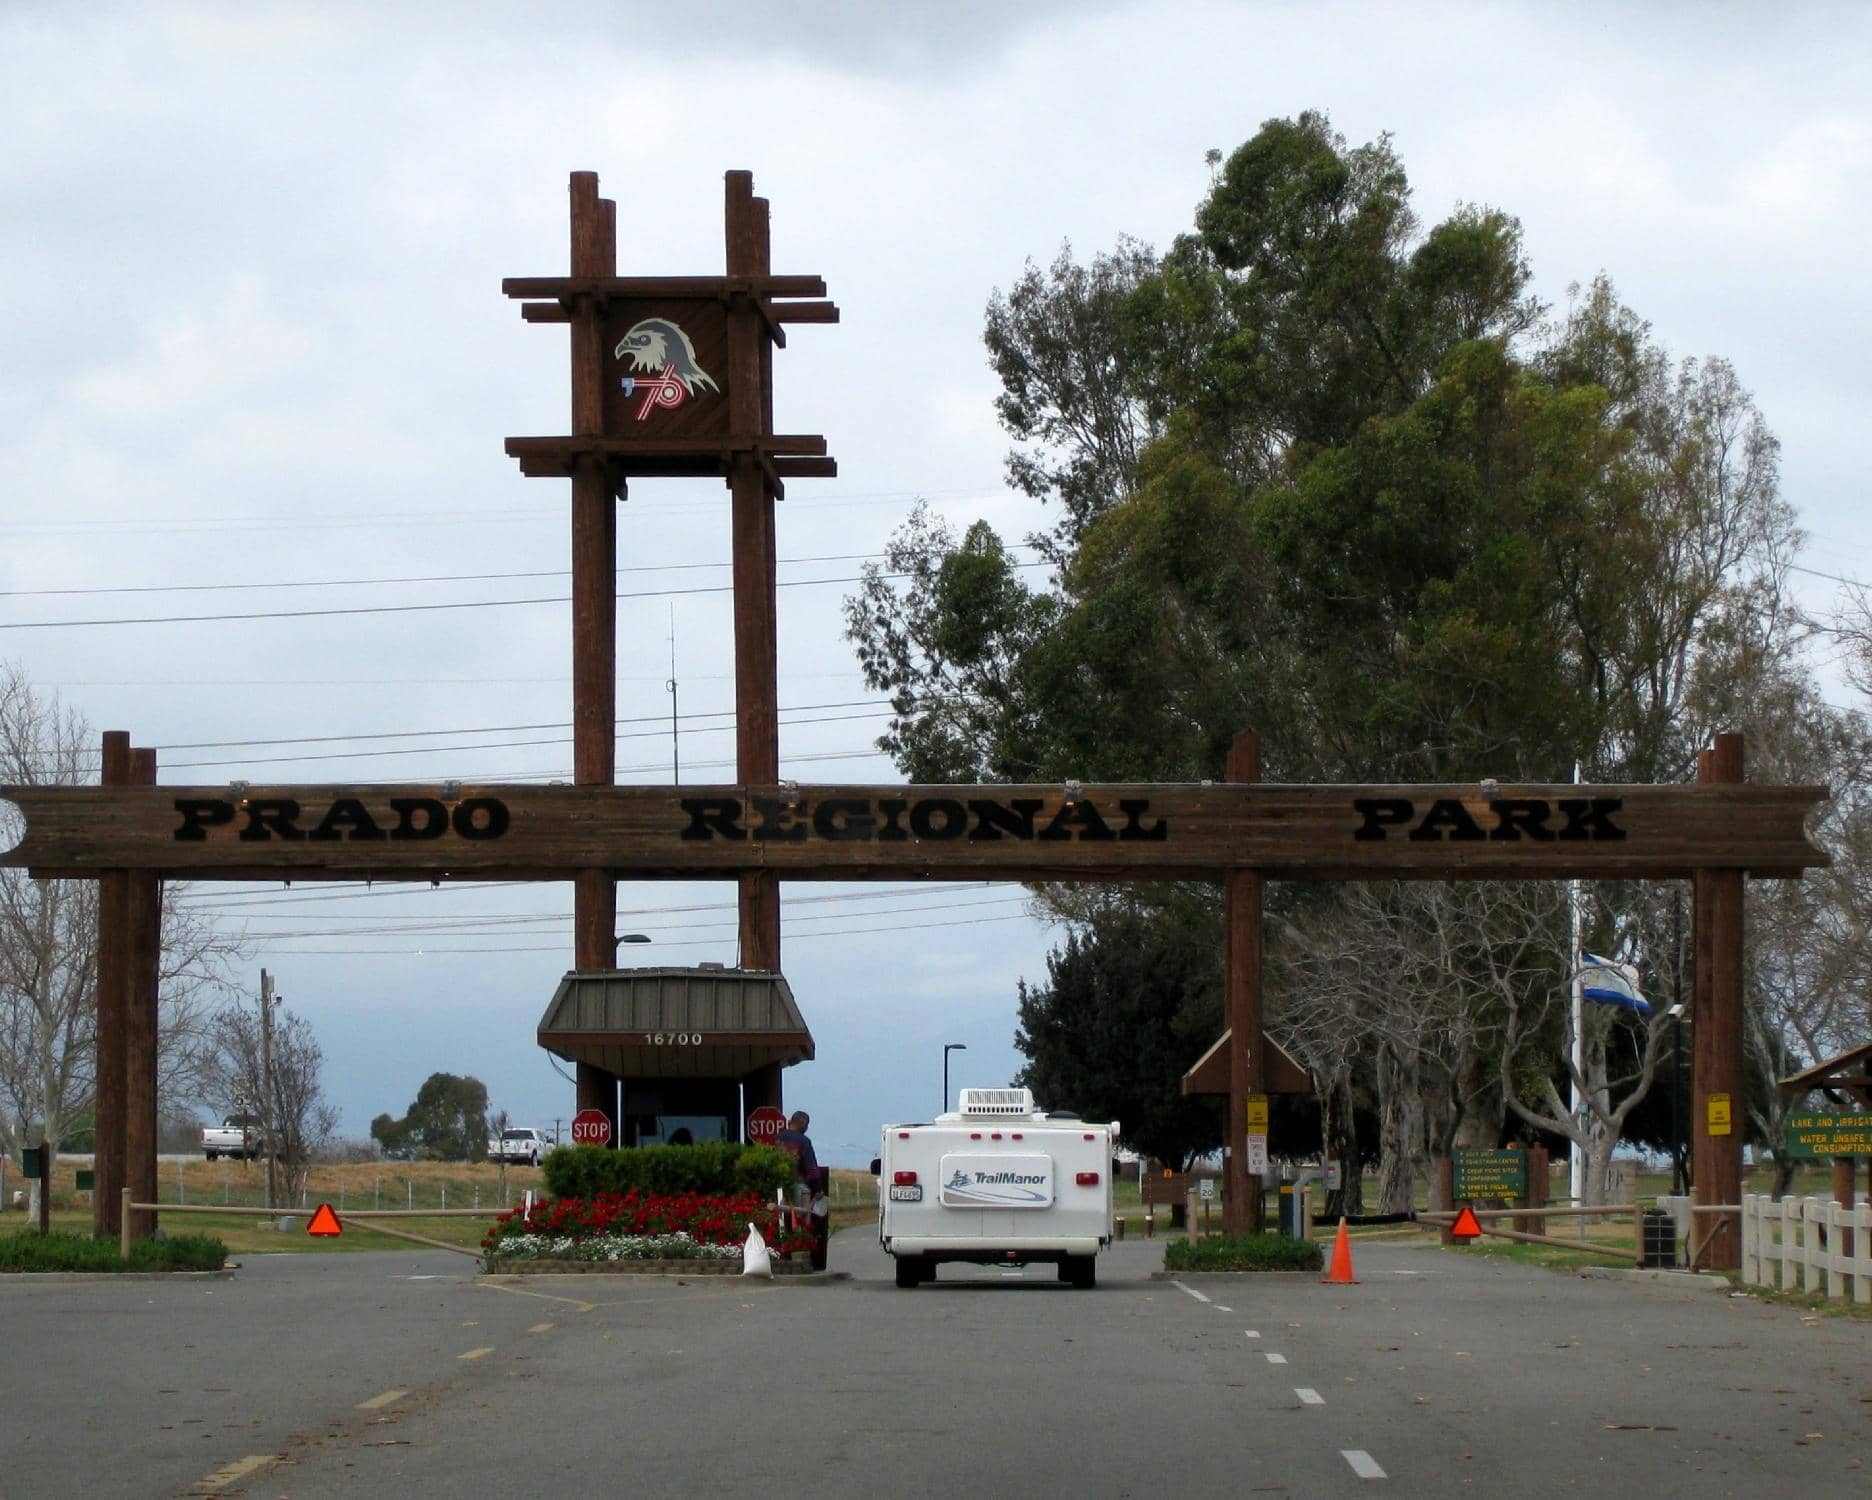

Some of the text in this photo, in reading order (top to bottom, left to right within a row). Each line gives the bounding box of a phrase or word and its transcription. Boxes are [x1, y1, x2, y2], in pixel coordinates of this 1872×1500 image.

[174, 798, 1627, 841] PRADO REGIONAL PARK
[645, 1033, 702, 1046] 16700
[574, 1122, 609, 1138] STOP
[750, 1119, 785, 1135] STOP
[1791, 1118, 1812, 1129] LAKE
[1817, 1118, 1833, 1128] AND
[1800, 1134, 1827, 1144] WATER
[1833, 1133, 1865, 1144] UNSAFE
[975, 1172, 1046, 1185] TrailManor
